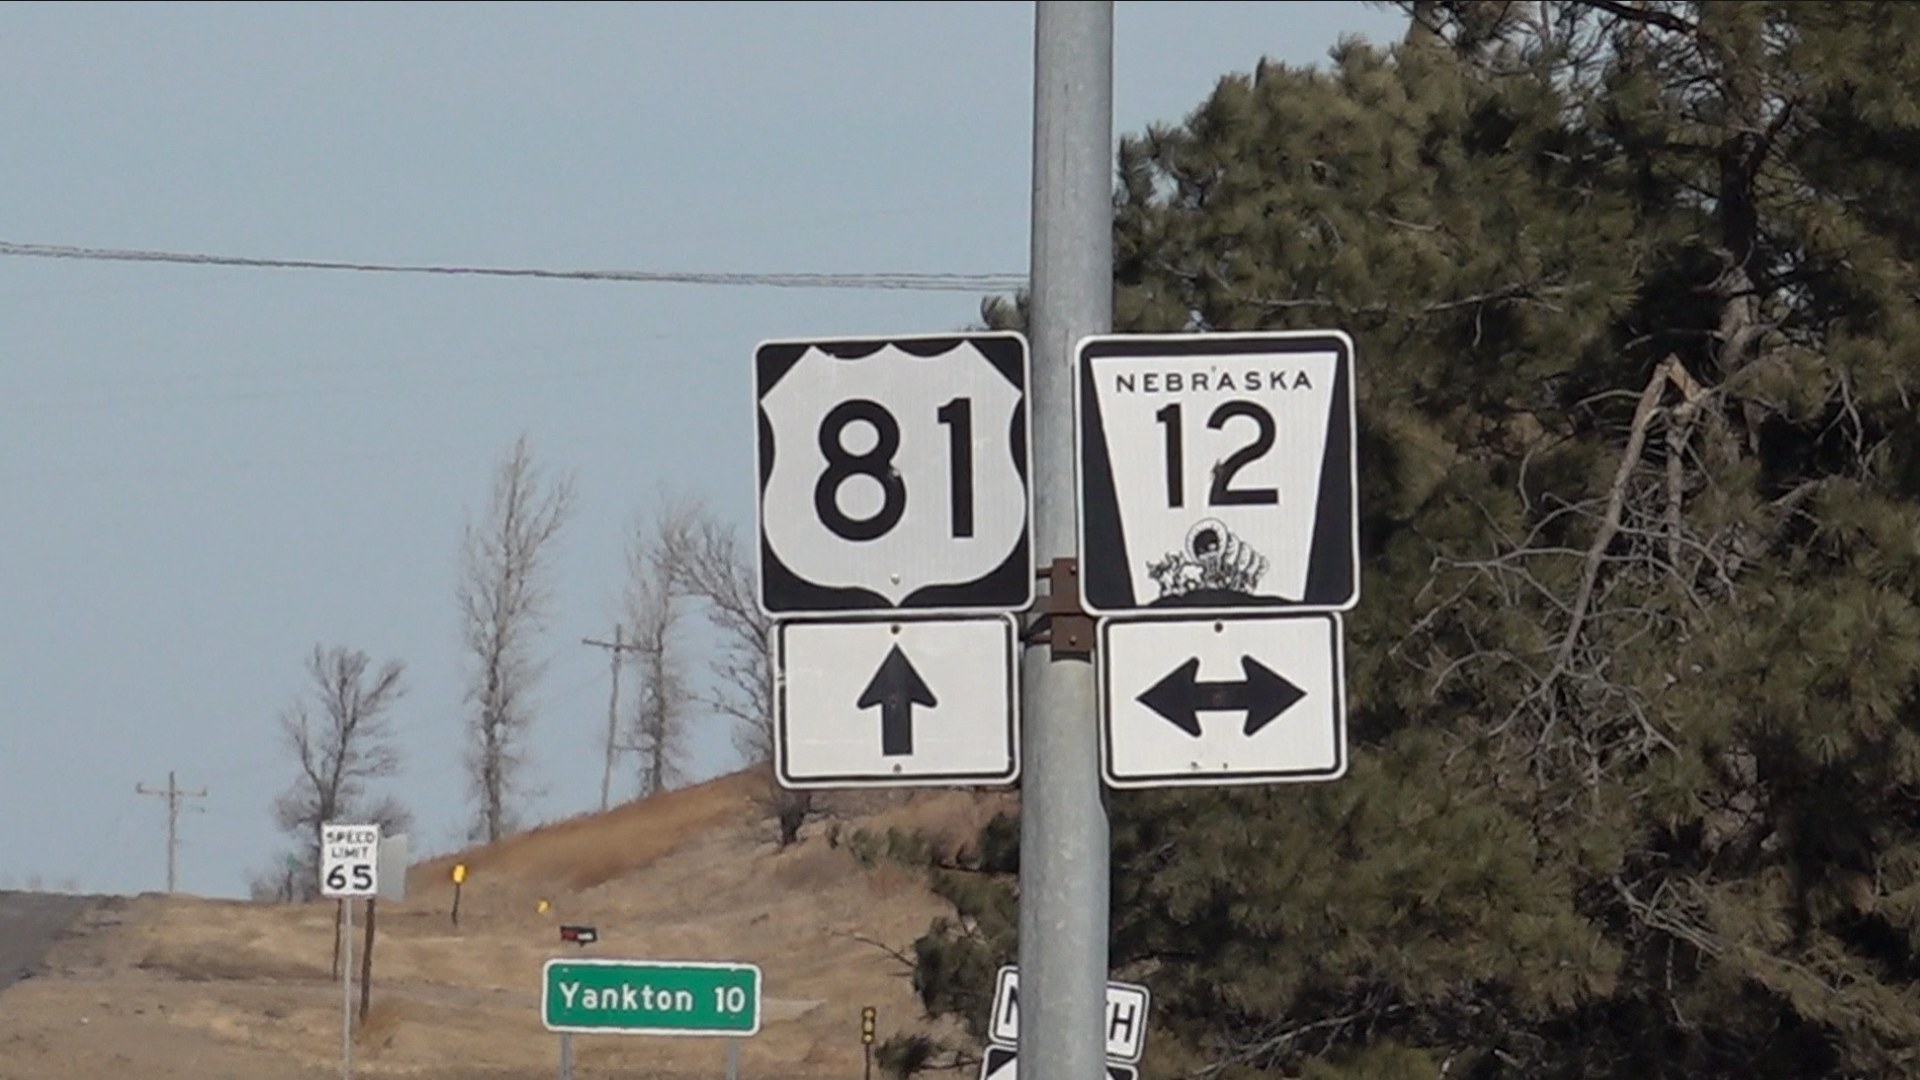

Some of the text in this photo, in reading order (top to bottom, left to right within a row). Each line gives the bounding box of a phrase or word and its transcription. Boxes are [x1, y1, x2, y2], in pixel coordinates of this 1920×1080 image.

[1116, 371, 1312, 392] NEBRASKA
[1156, 400, 1279, 508] 12
[814, 397, 974, 541] 81
[326, 831, 376, 844] SPEED
[331, 846, 368, 858] LIMIT
[326, 864, 373, 890] 65
[559, 981, 746, 1013] Yankton 10
